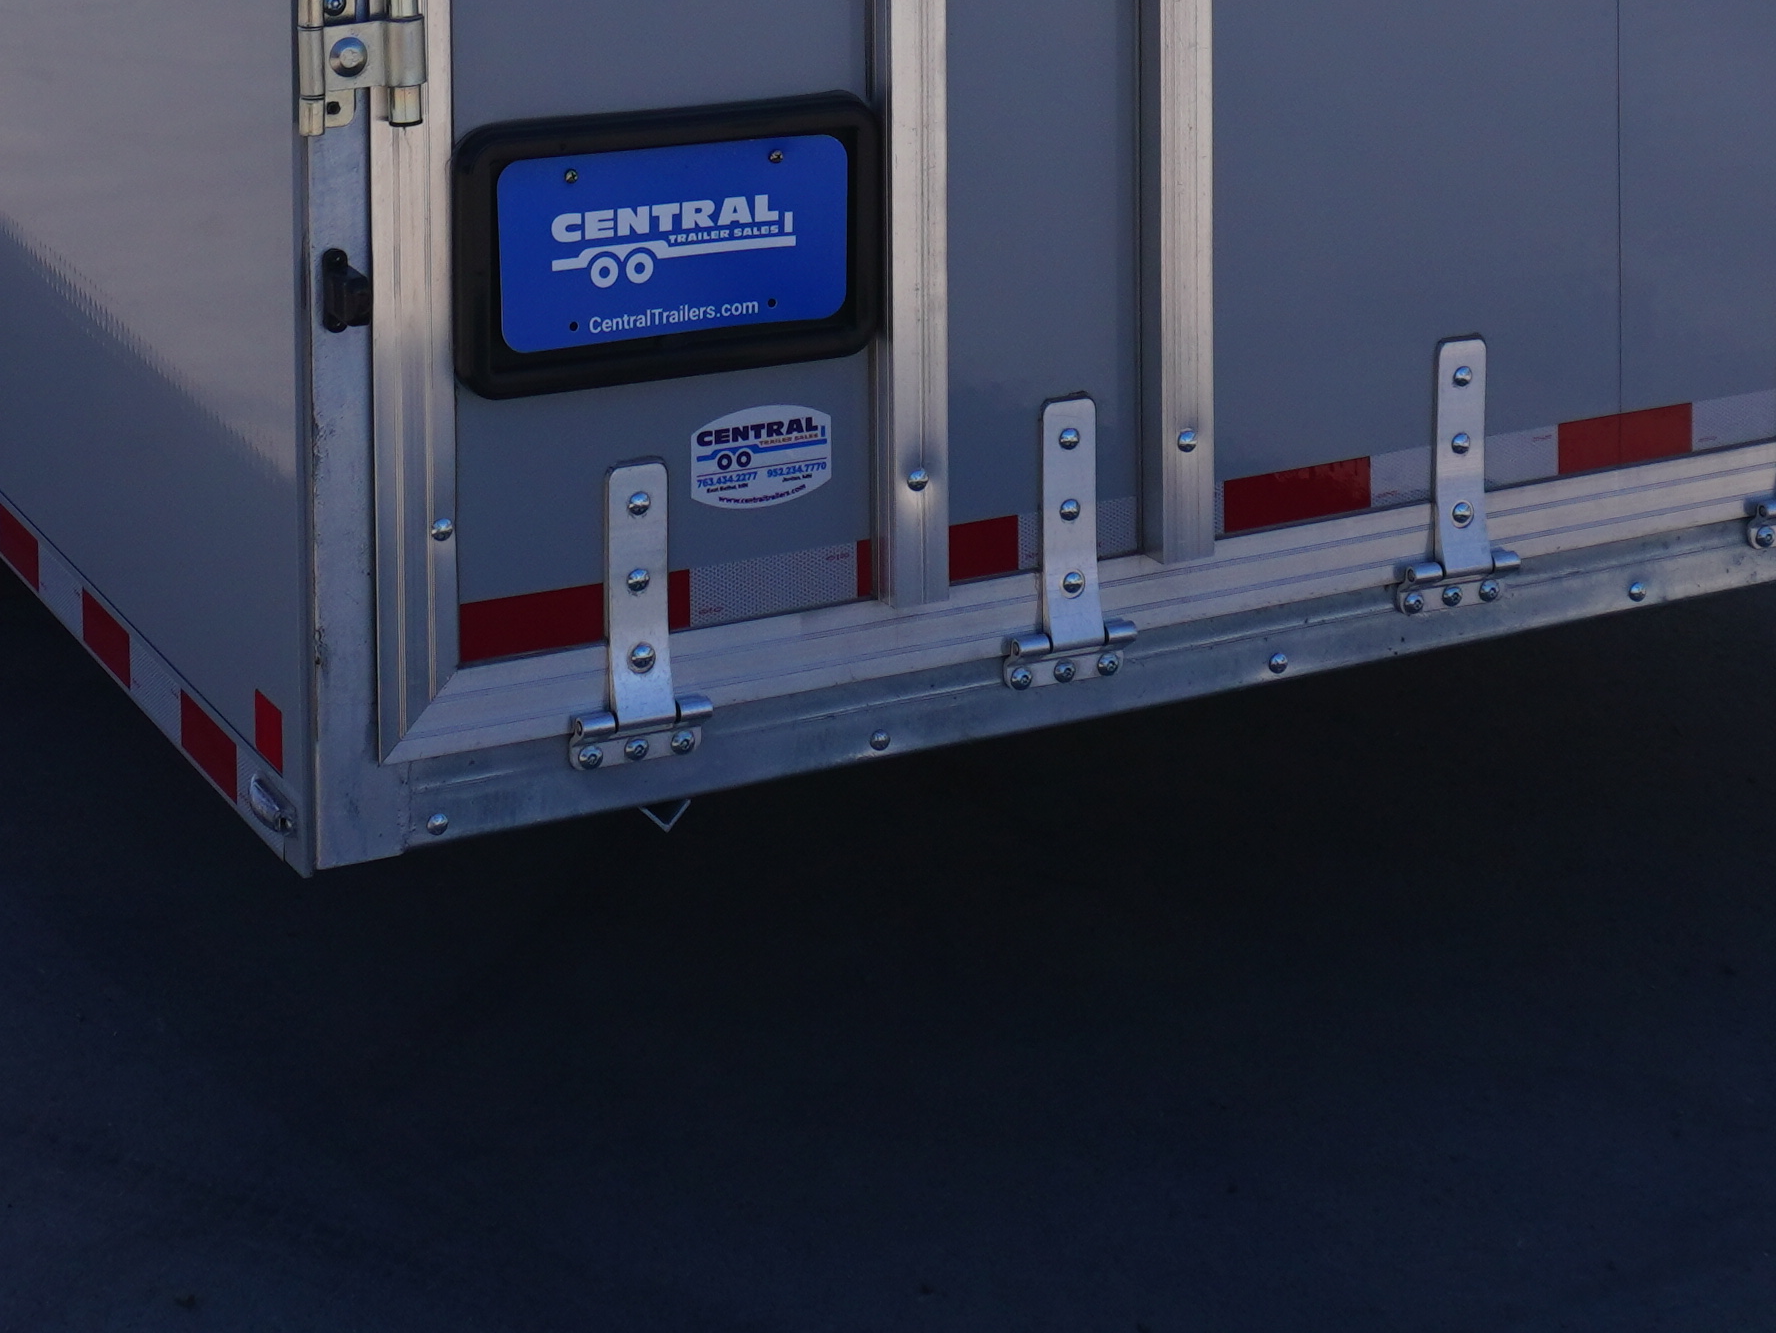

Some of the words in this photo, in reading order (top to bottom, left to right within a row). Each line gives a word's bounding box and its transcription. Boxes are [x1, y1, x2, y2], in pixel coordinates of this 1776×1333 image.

[551, 194, 779, 243] CENTRAL
[668, 229, 730, 244] TRAILER
[734, 225, 779, 237] SALES
[589, 298, 760, 334] CentralTrailers.com
[697, 417, 818, 447] CENTRAL
[759, 435, 792, 446] TRAILER
[794, 433, 819, 442] SALES
